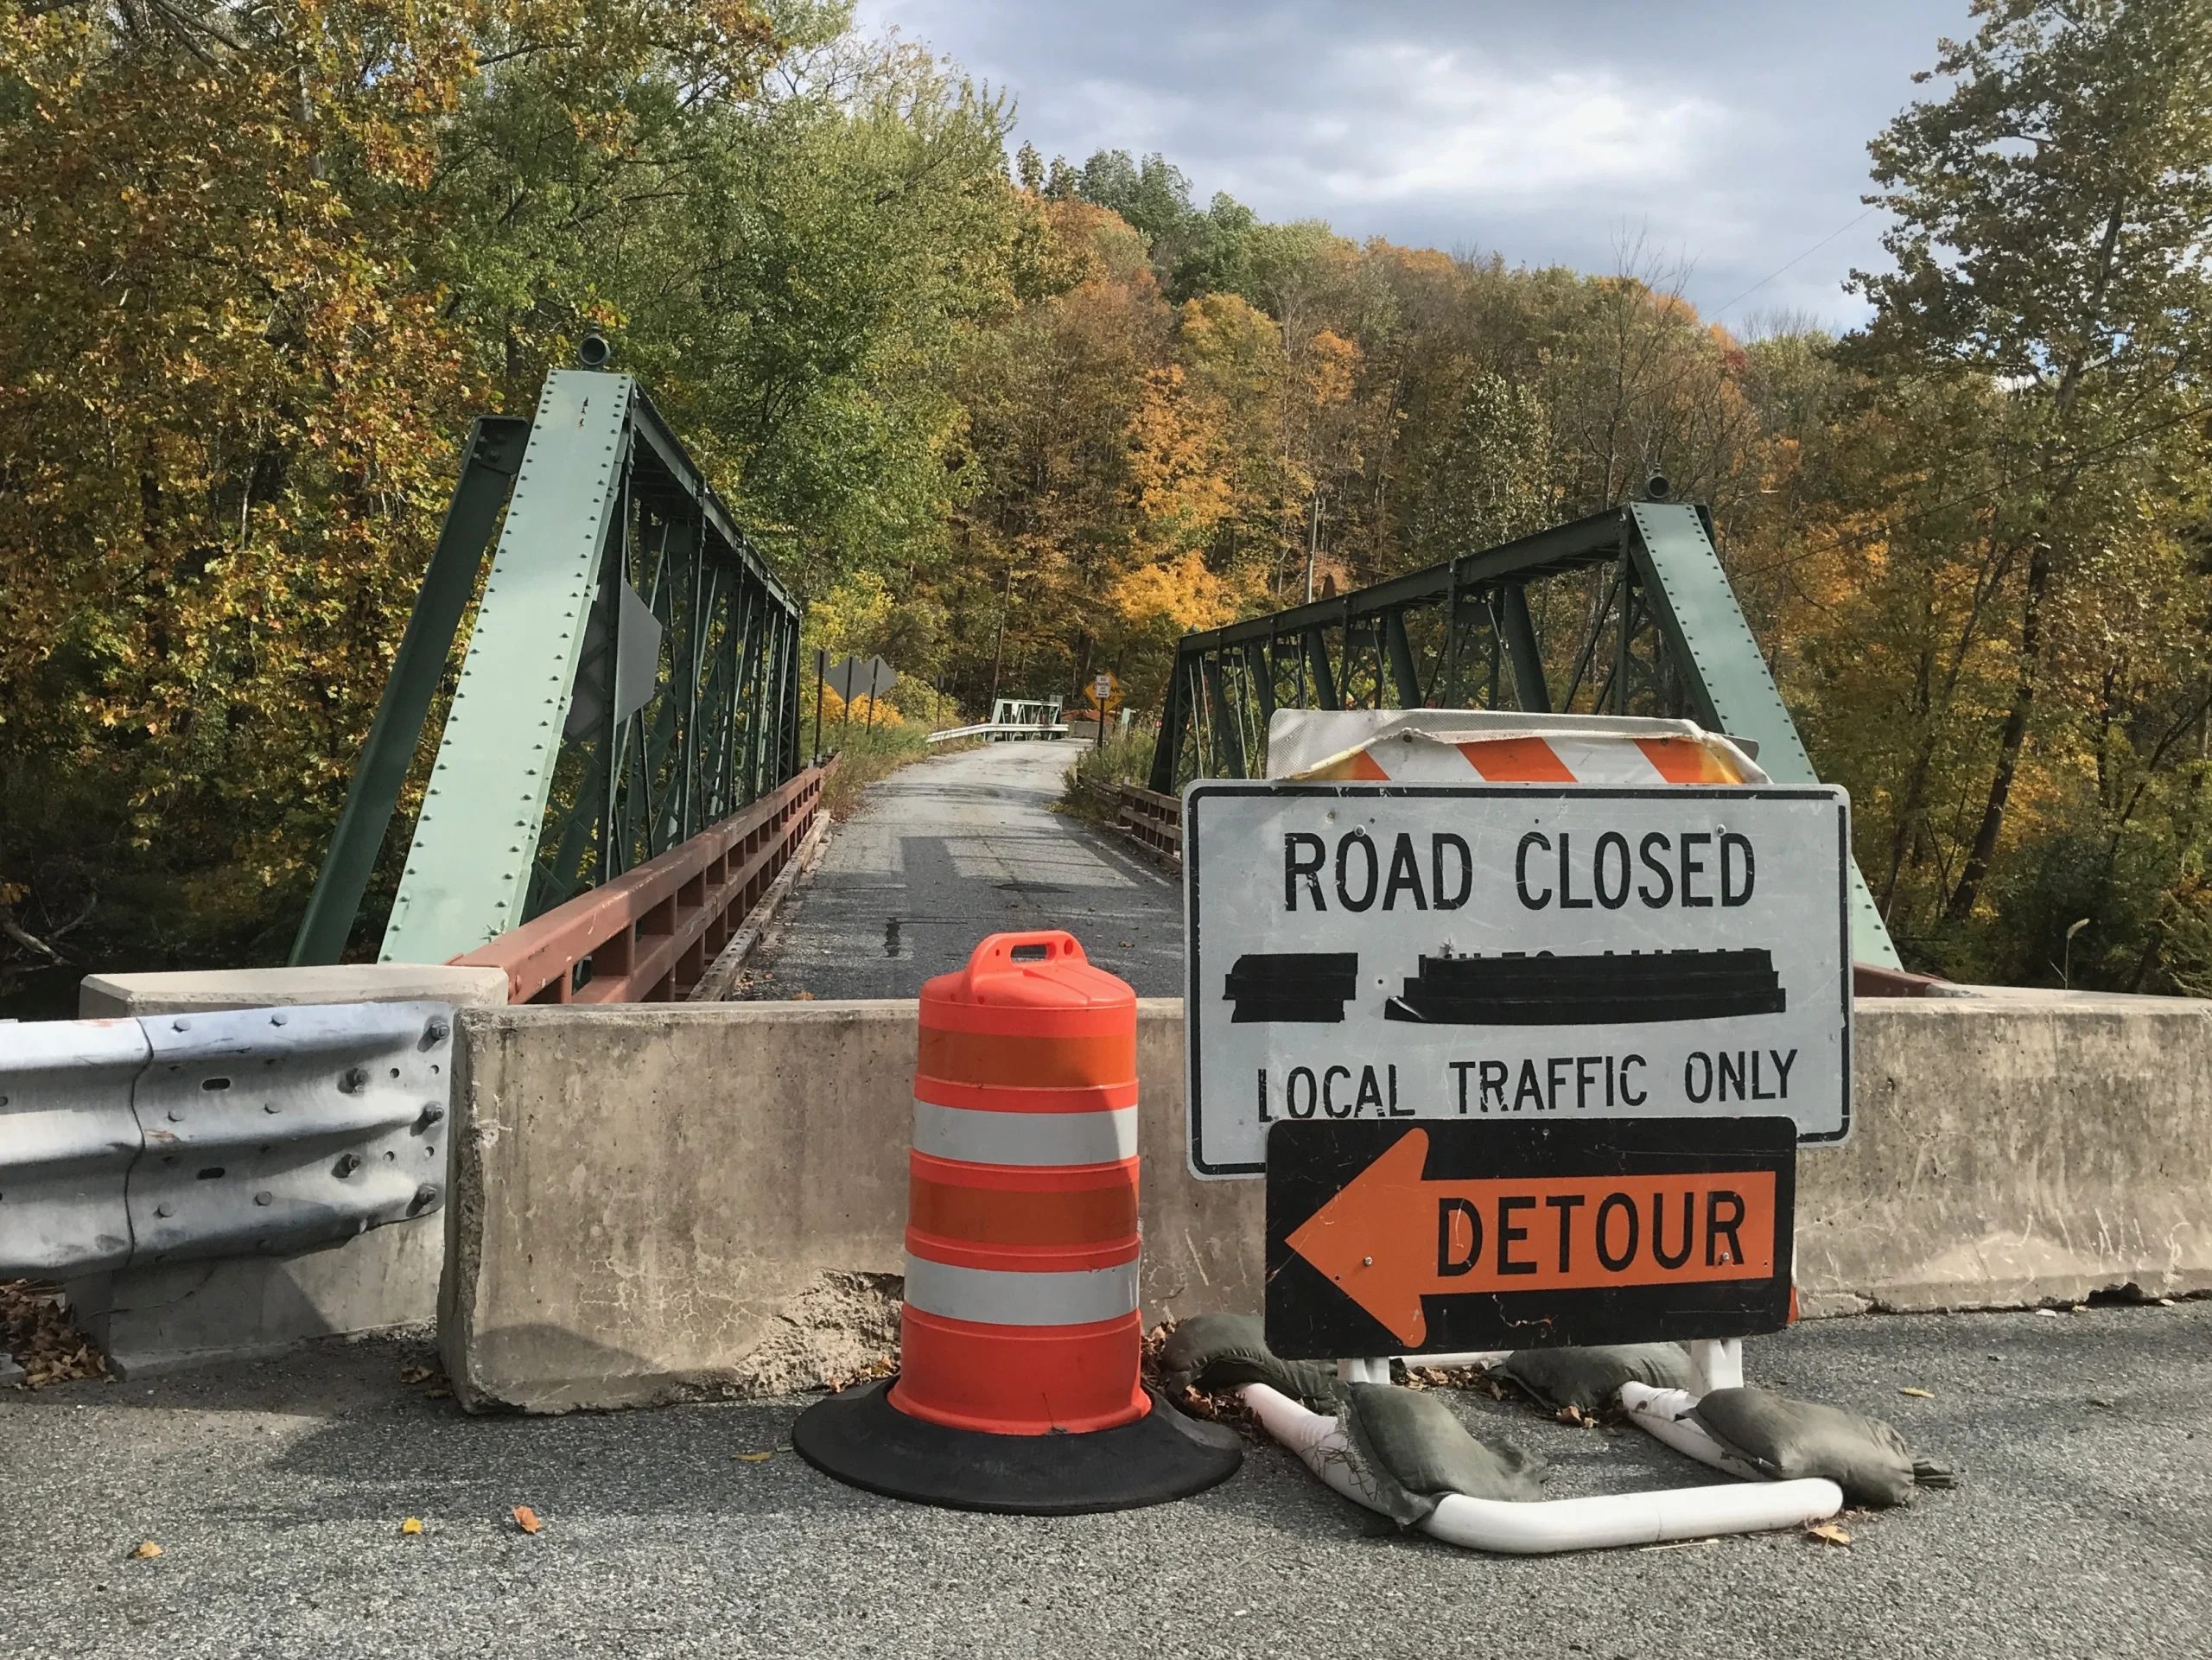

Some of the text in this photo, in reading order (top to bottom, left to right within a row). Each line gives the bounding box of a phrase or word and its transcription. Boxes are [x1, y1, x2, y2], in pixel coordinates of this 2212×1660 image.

[1284, 830, 1757, 913] ROAD CLOSED
[1258, 1048, 1798, 1122] LOCAL TRAFFIC ONLY
[1437, 1190, 1745, 1278] DETOUR
